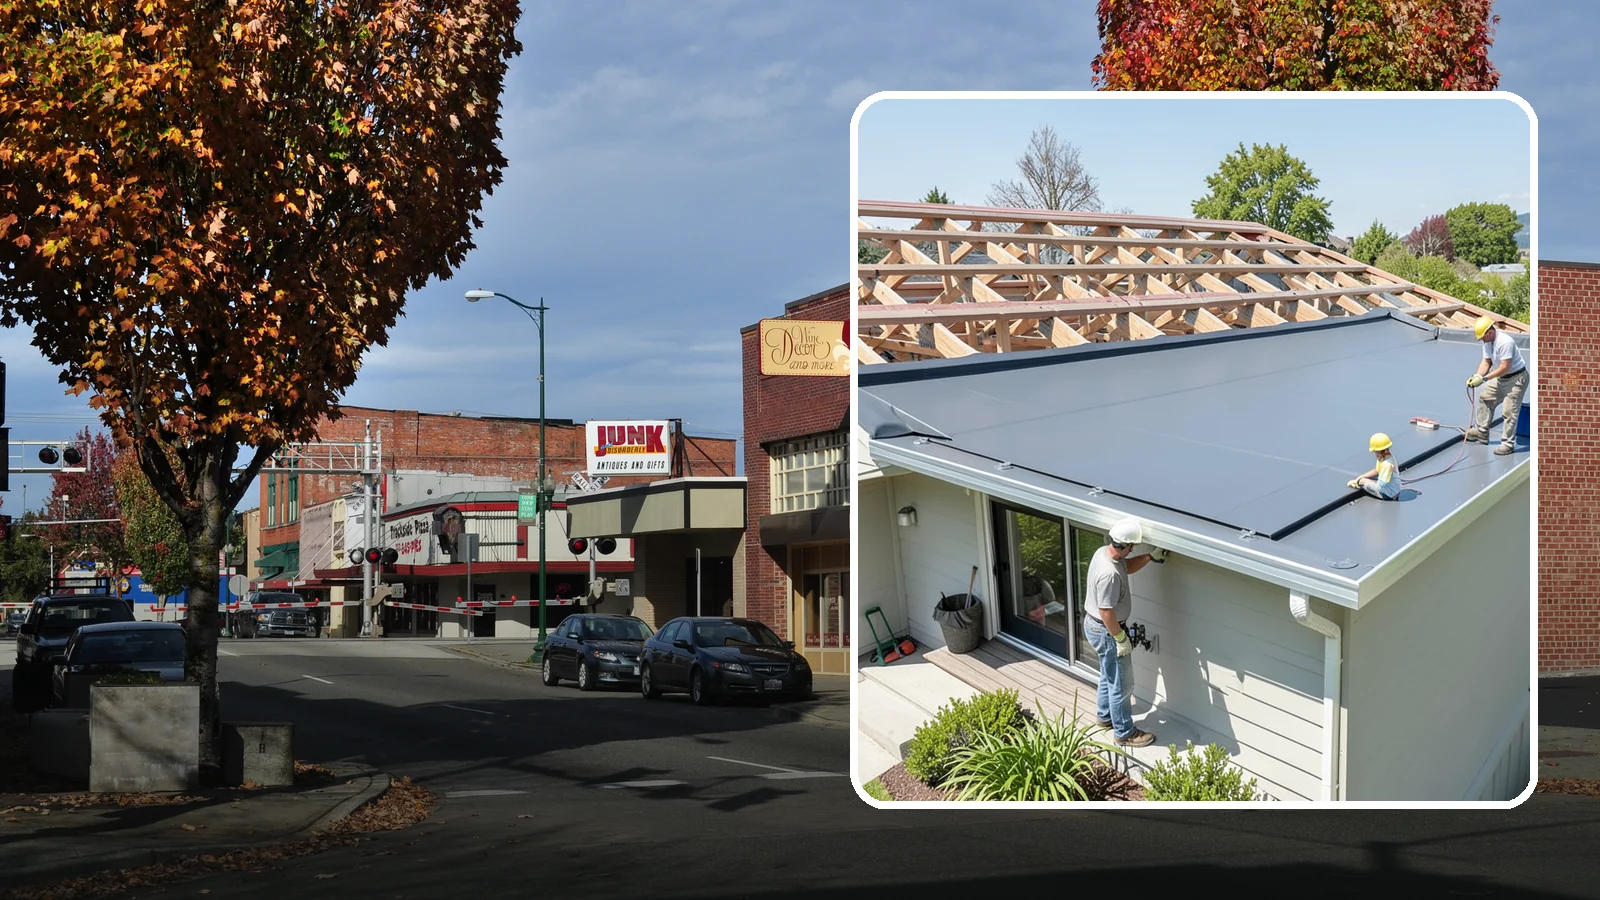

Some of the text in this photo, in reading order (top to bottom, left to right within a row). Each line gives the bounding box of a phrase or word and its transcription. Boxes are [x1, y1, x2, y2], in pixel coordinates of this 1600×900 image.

[595, 424, 665, 457] JUNK
[607, 446, 646, 454] DISORDERLY
[597, 460, 665, 470] ANTIQUES AND GIFTS
[573, 473, 588, 492] RAIL
[352, 498, 365, 511] CRO
[390, 519, 429, 539] Trackside Pizza
